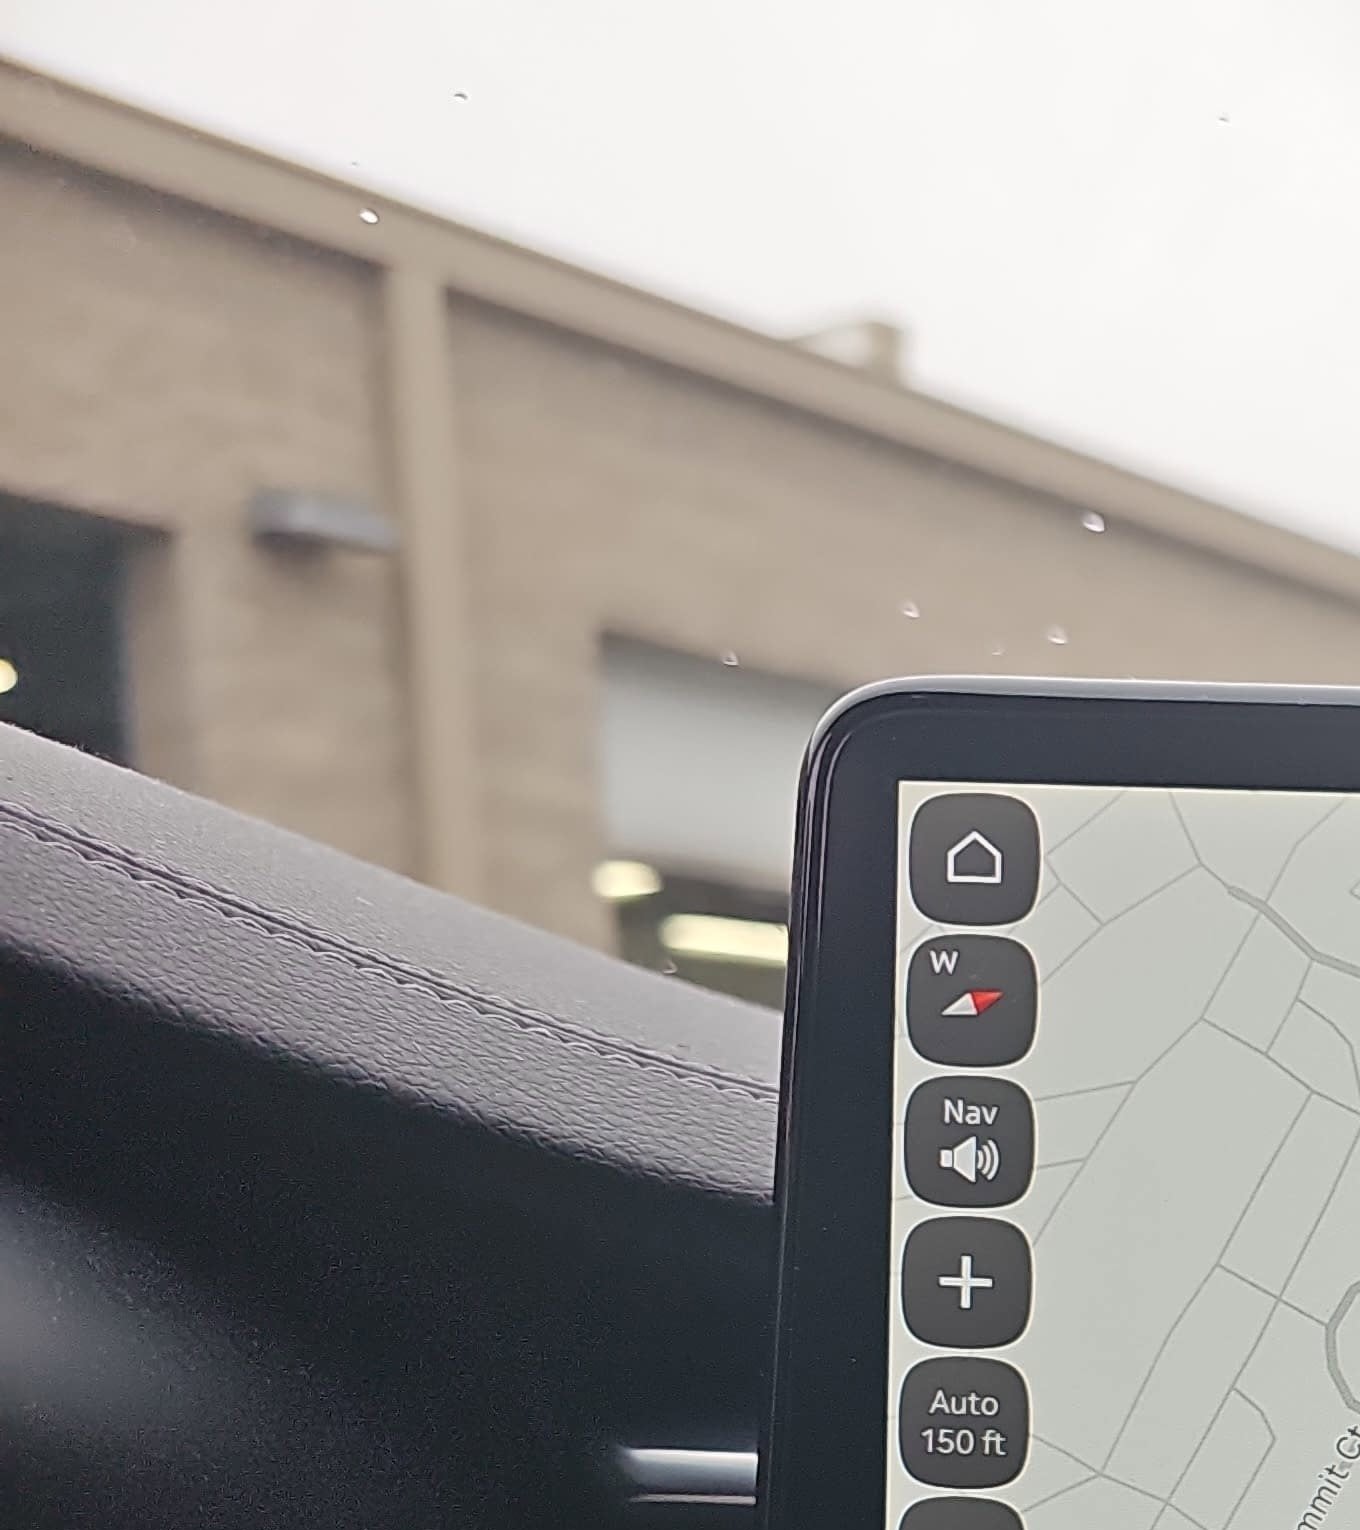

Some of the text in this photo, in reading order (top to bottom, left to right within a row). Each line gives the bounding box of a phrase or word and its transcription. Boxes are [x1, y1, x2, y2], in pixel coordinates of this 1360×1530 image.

[929, 949, 959, 975] W
[943, 1098, 999, 1126] Nav
[928, 1389, 1000, 1416] Auto
[920, 1428, 1007, 1456] 150 ft
